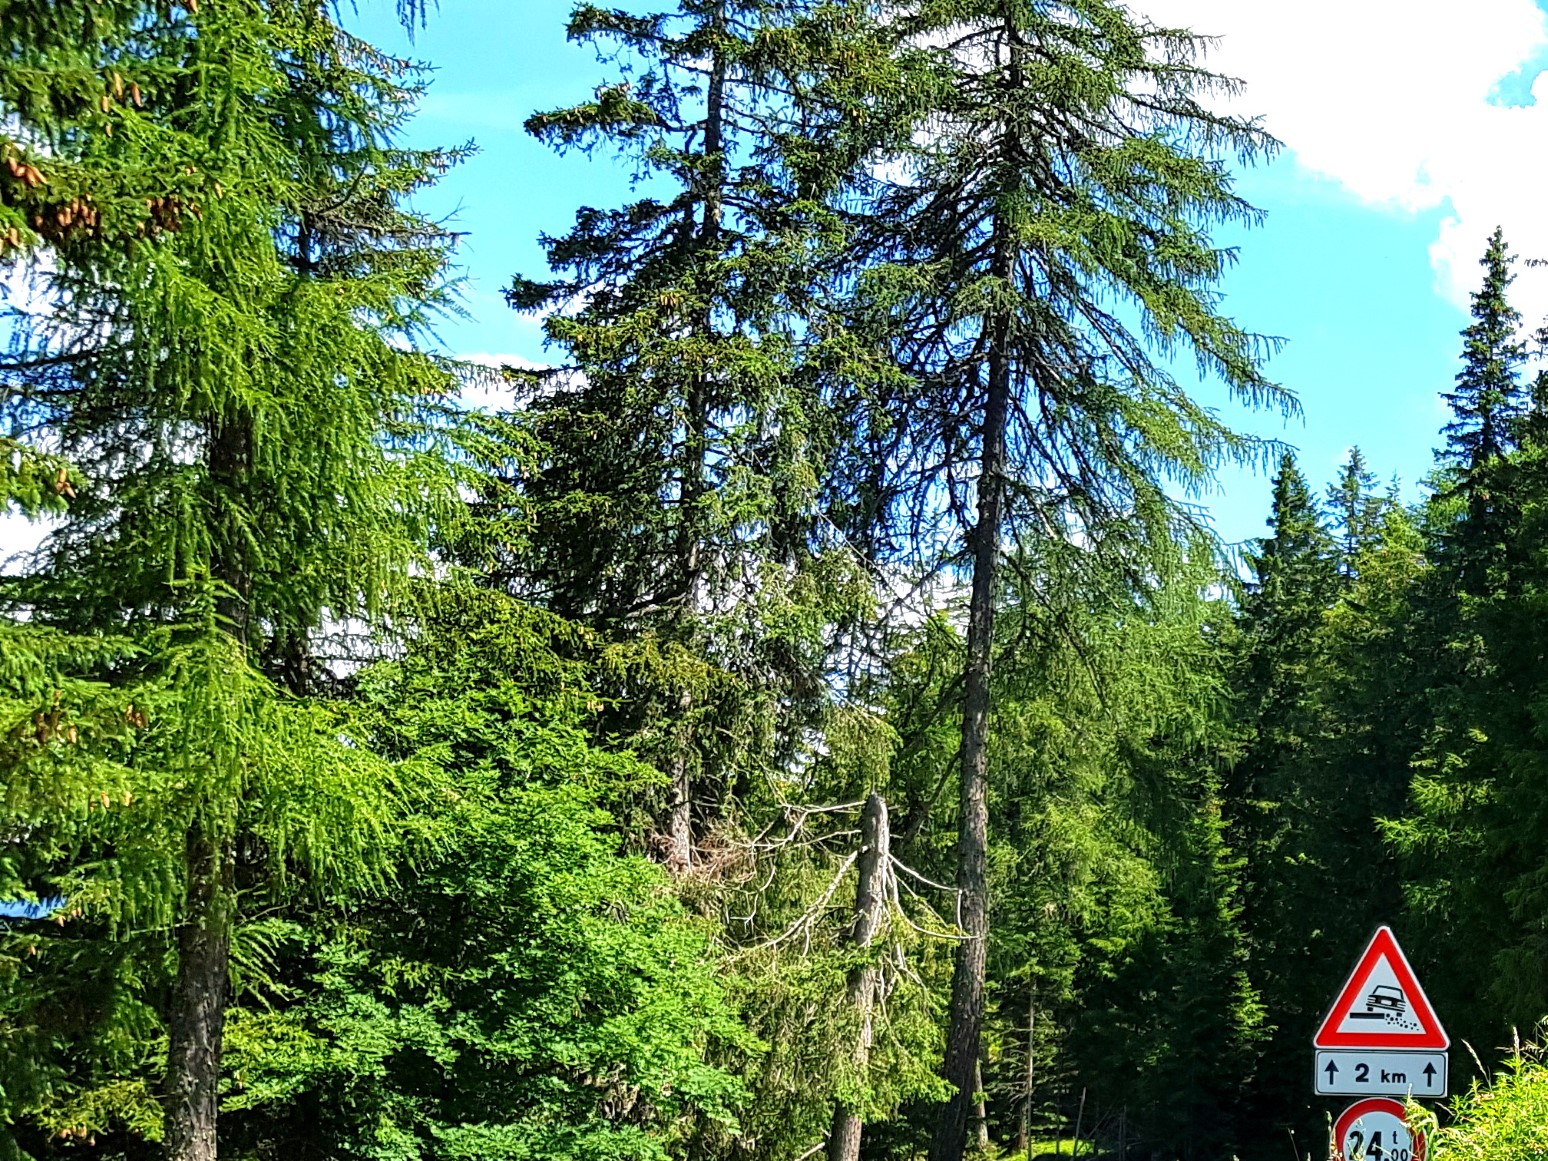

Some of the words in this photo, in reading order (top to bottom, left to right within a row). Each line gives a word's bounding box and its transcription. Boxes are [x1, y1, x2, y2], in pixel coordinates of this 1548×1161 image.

[1354, 1062, 1370, 1083] 2
[1380, 1069, 1407, 1084] km
[1392, 1130, 1399, 1145] t
